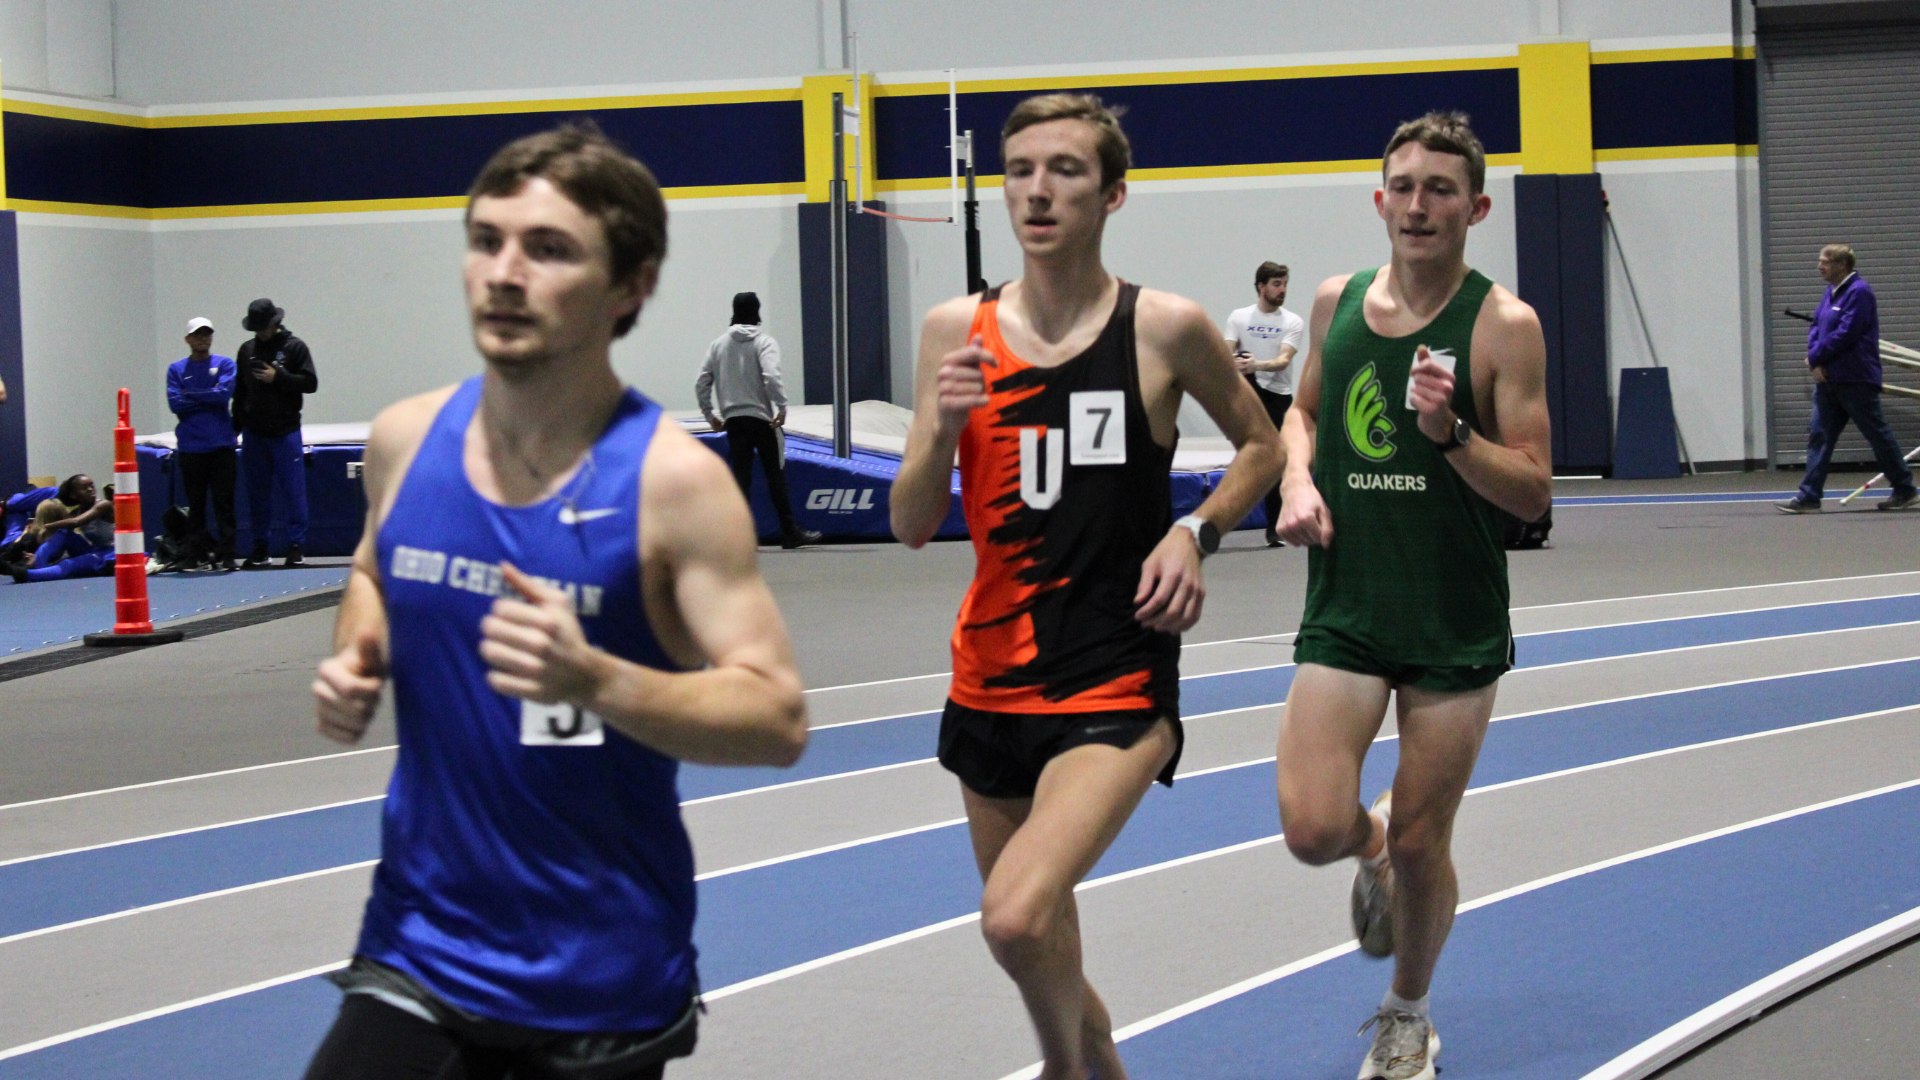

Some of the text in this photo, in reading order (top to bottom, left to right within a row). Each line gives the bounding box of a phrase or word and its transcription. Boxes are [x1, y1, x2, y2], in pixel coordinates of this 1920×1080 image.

[1086, 407, 1112, 449] 7
[1020, 428, 1064, 510] U
[1347, 473, 1427, 491] QUAKERS
[805, 488, 875, 510] GILL
